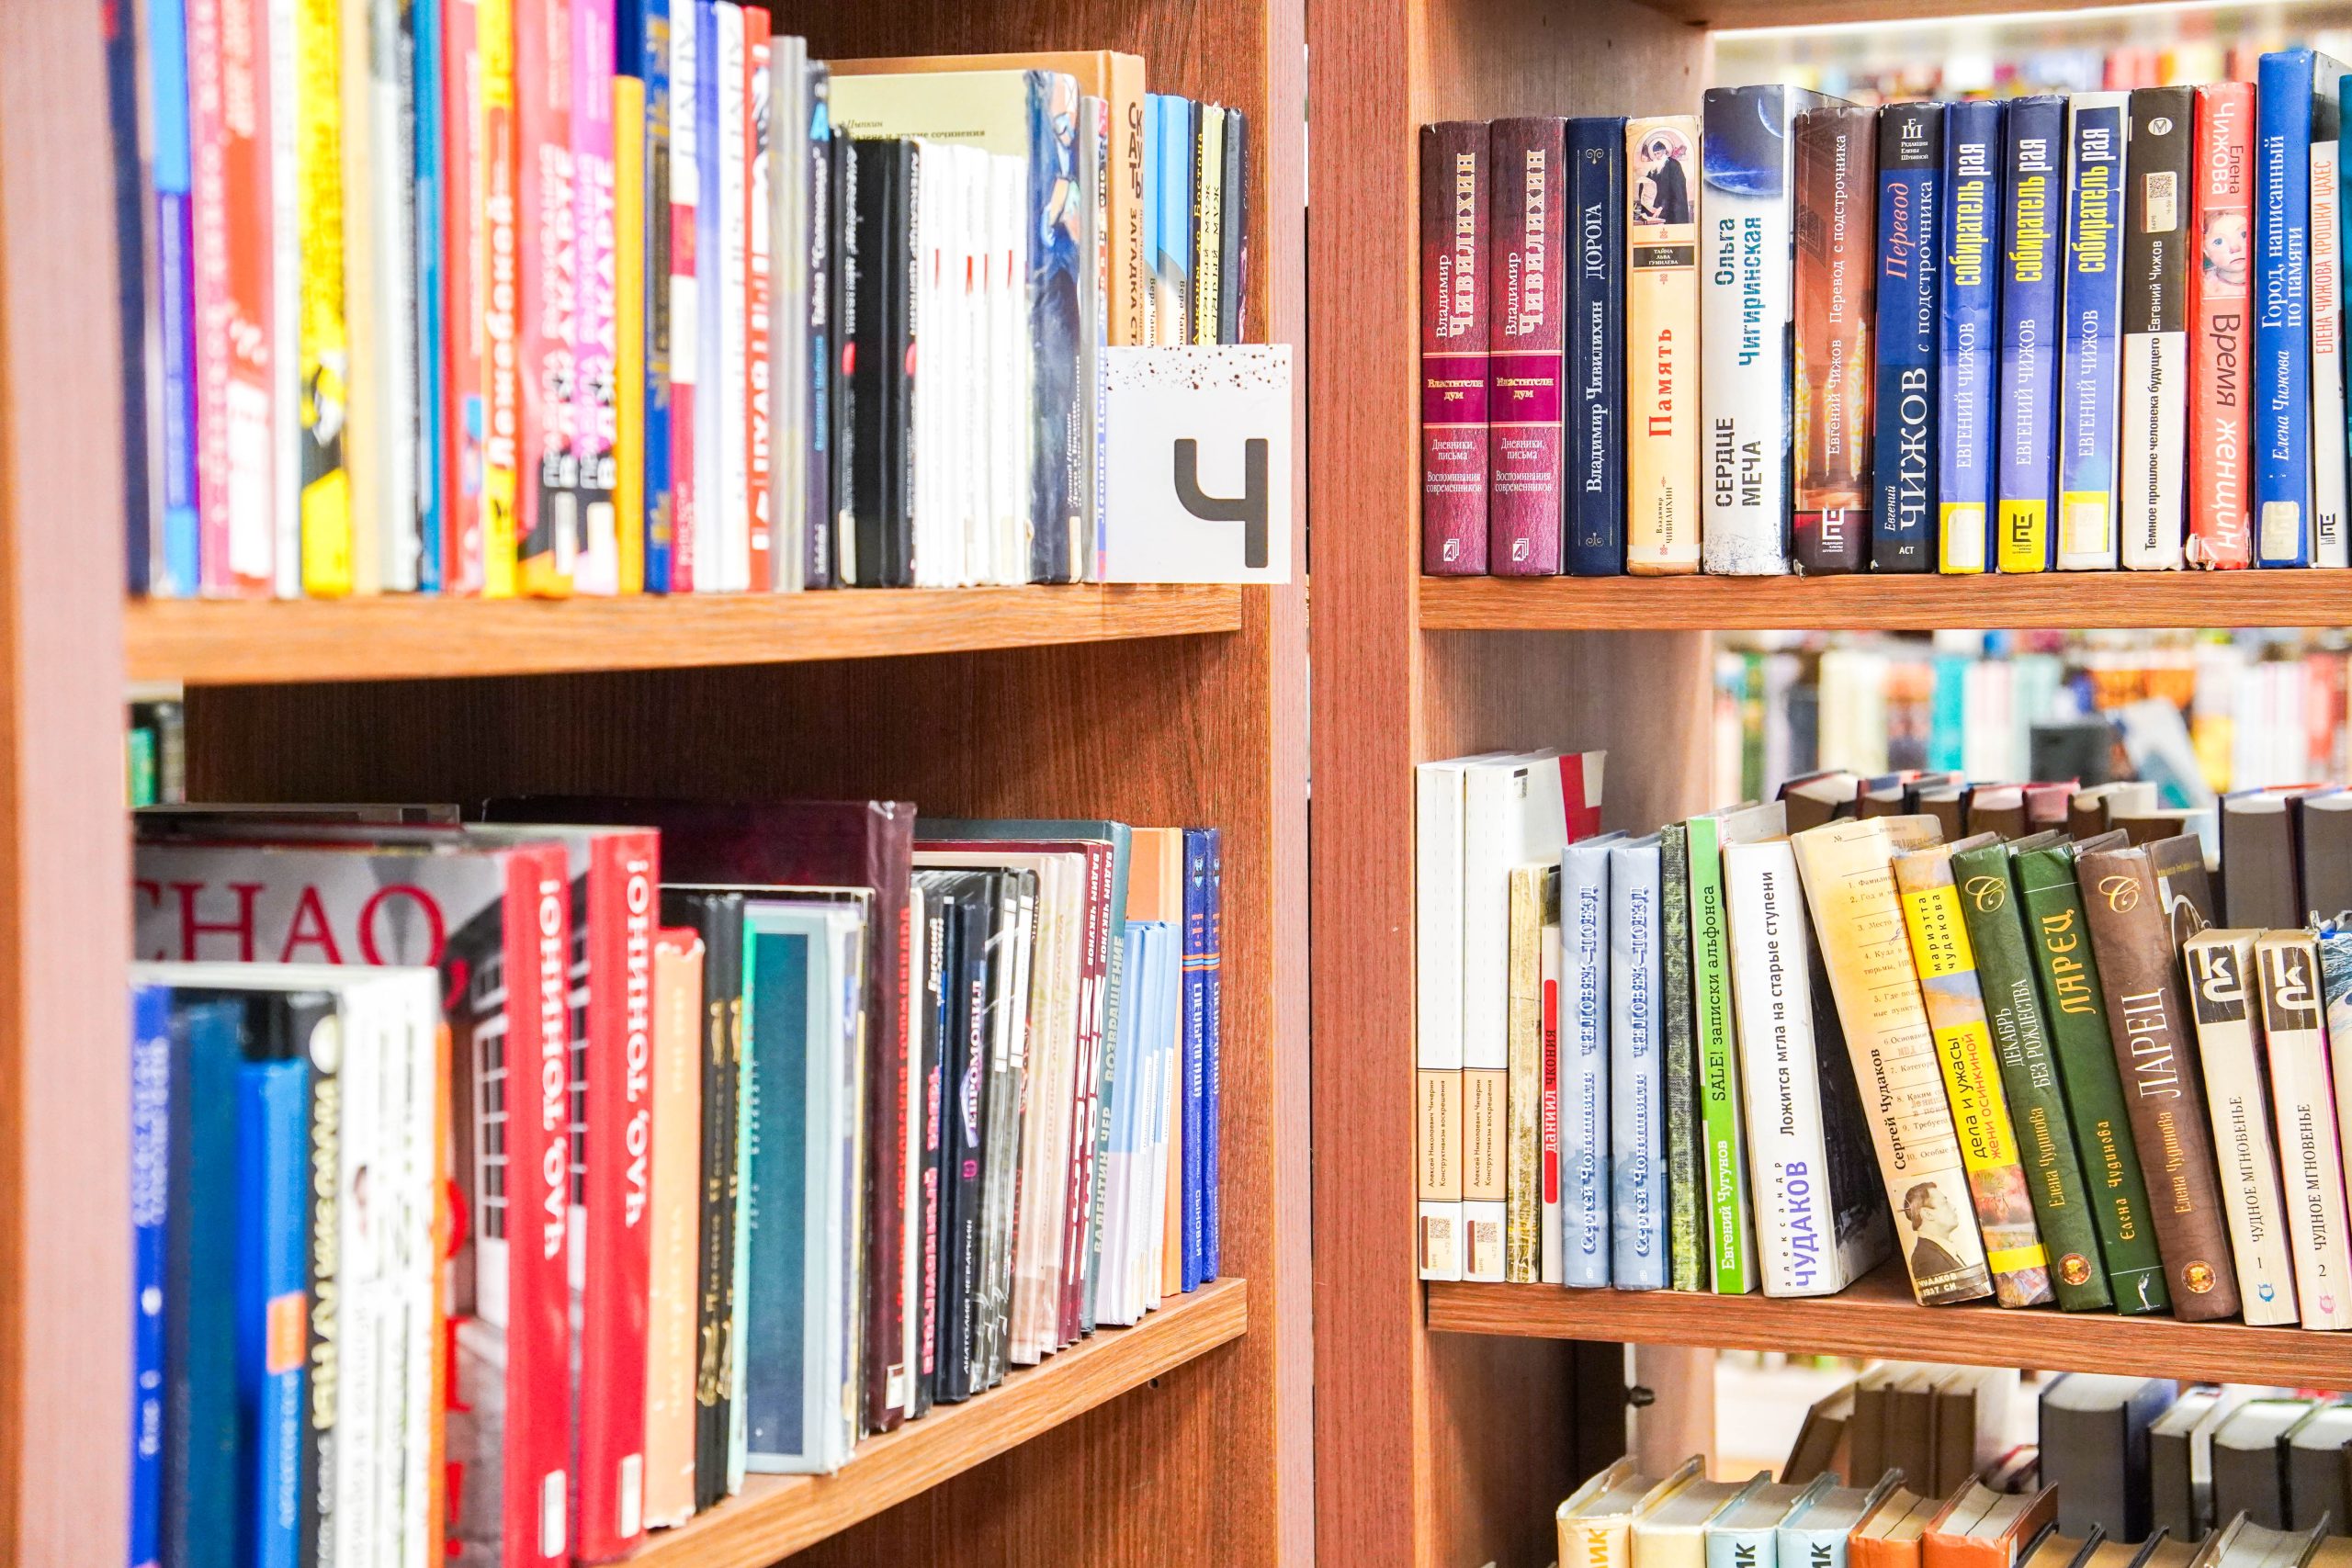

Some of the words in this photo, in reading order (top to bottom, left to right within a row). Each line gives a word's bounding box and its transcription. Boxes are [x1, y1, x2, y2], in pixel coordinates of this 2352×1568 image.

[1193, 132, 1203, 218] Бостона
[1959, 142, 1991, 176] рая
[2020, 139, 2052, 172] рая
[2081, 128, 2110, 163] рая
[2211, 101, 2235, 196] Чижова
[2229, 144, 2245, 195] Елена
[1835, 135, 1848, 243] подстрочника
[2264, 135, 2285, 258] написанный
[2319, 161, 2334, 197] ЦАХЕС
[1449, 153, 1475, 337] Чивилихин
[1519, 150, 1544, 335] Чивилихин
[1586, 202, 1602, 279] ДОРОГА
[1886, 182, 1915, 279] Перевод
[1950, 181, 1988, 286] собиратель
[2009, 176, 2050, 282] собиратель
[2073, 164, 2108, 273] собиратель
[2319, 202, 2333, 256] КРОШКИ
[1129, 208, 1137, 309] ЗАГАДКА
[1715, 218, 1736, 286] Ольга
[1917, 180, 1937, 334] подстрочника
[2149, 241, 2162, 282] Чижов
[2287, 228, 2303, 299] памяти
[1436, 254, 1448, 337] Владимир
[1505, 252, 1521, 337] Владимир
[1739, 217, 1762, 366] Чигиринская
[1829, 260, 1845, 323] Перевод
[2148, 286, 2160, 332] Евгений
[2262, 263, 2287, 328] Город,
[2288, 304, 2301, 327] по
[2316, 263, 2332, 314] ЧИЖОВА
[1587, 300, 1602, 401] Чивилихин
[1828, 340, 1842, 389] Чижов
[1919, 344, 1929, 352] с
[1959, 321, 1974, 389] ЧИЖОВ
[2019, 319, 2035, 386] ЧИЖОВ
[2083, 310, 2098, 374] ЧИЖОВ
[2148, 337, 2162, 392] будущего
[2209, 312, 2241, 408] Время
[2316, 317, 2334, 355] ЕЛЕНА
[1444, 389, 1464, 400] дум
[1648, 328, 1672, 437] Память
[2272, 350, 2290, 411] Чижова
[1432, 437, 1475, 452] Дневники,
[1587, 403, 1607, 492] Владимир
[1828, 393, 1840, 456] Евгений
[1900, 367, 1927, 530] ЧИЖОВ
[1957, 392, 1972, 468] ЕВГЕНИЙ
[2017, 389, 2032, 467] ЕВГЕНИЙ
[2079, 378, 2096, 458] ЕВГЕНИЙ
[2149, 396, 2158, 449] человека
[2271, 412, 2290, 461] Елена
[1427, 470, 1481, 481] Воспоминания
[1438, 449, 1468, 461] письма
[1715, 418, 1735, 507] СЕРДЦЕ
[1742, 440, 1761, 507] МЕЧА
[2148, 455, 2159, 505] прошлое
[2214, 418, 2237, 549] женщин
[1174, 439, 1268, 569] Ч
[1426, 481, 1482, 494] современников
[1656, 497, 1664, 535] Владимир
[1665, 487, 1673, 544] ЧИВИЛИХИН
[1884, 485, 1897, 532] Евгений
[1899, 546, 1914, 555] АСТ
[2145, 506, 2157, 551] Темное
[1091, 852, 1100, 901] ВАДИМ
[1102, 851, 1113, 900] ВАДИМ
[1763, 872, 1779, 937] ступени
[1860, 893, 1876, 901] Год
[1088, 907, 1097, 965] ЧЕКУНОВ
[1100, 907, 1110, 964] ЧЕКУНОВ
[1702, 885, 1720, 968] альфонса
[1869, 919, 1893, 930] Место
[1918, 897, 1941, 971] мариэтта
[1933, 895, 1956, 969] чудакова
[626, 860, 650, 1102] ТОНИНО!
[1768, 941, 1784, 998] старые
[2041, 908, 2097, 1015] ЛАРЕЦ
[539, 879, 565, 1131] ТОНИНО!
[1710, 971, 1724, 1044] записки
[1773, 1002, 1784, 1023] на
[2011, 978, 2044, 1059] РОЖДЕСТВА
[1775, 1025, 1788, 1062] мгла
[1948, 1038, 1973, 1094] ужасы
[1996, 1008, 2026, 1067] ДЕКАБРЬ
[2121, 987, 2181, 1099] ЛАРЕЦ
[1093, 1151, 1109, 1253] ВАЛЕНТИН
[1104, 935, 1124, 1081] ВОЗВРАЩЕНИЕ
[1712, 1051, 1726, 1101] SALE!
[1781, 1066, 1794, 1136] Ложится
[1871, 1049, 1893, 1113] Чудаков
[1907, 1090, 1932, 1101] Каким
[1962, 1033, 1991, 1117] осинкиной
[1962, 1099, 1974, 1110] и
[2030, 1063, 2051, 1089] БЕЗ
[1544, 1090, 1557, 1153] даниил
[1580, 1069, 1595, 1183] Чонишвили
[1634, 1071, 1648, 1186] Чонишвили
[1884, 1117, 1906, 1170] Сергей
[1920, 1147, 1949, 1158] Особые
[1965, 1115, 1988, 1158] дела
[1984, 1120, 2002, 1160] жени
[2029, 1107, 2057, 1168] Чудинова
[2157, 1111, 2185, 1172] Чудинова
[2229, 1096, 2255, 1182] МГНОВЕНЬЕ
[2297, 1103, 2320, 1190] МГНОВЕНЬЕ
[1718, 1140, 1733, 1202] Чугунов
[2097, 1121, 2124, 1189] Чудинова
[2045, 1169, 2065, 1208] Елена
[2116, 1198, 2135, 1240] Елена
[2172, 1176, 2191, 1213] Елена
[2245, 1186, 2265, 1243] ЧУДНОЕ
[1580, 1186, 1600, 1255] Сергей
[1634, 1190, 1653, 1257] Сергей
[1721, 1207, 1736, 1269] Евгений
[1787, 1160, 1820, 1289] ЧУДАКОВ
[2309, 1194, 2327, 1251] ЧУДНОЕ
[2257, 1257, 2262, 1269] 1
[2318, 1264, 2327, 1277] 2
